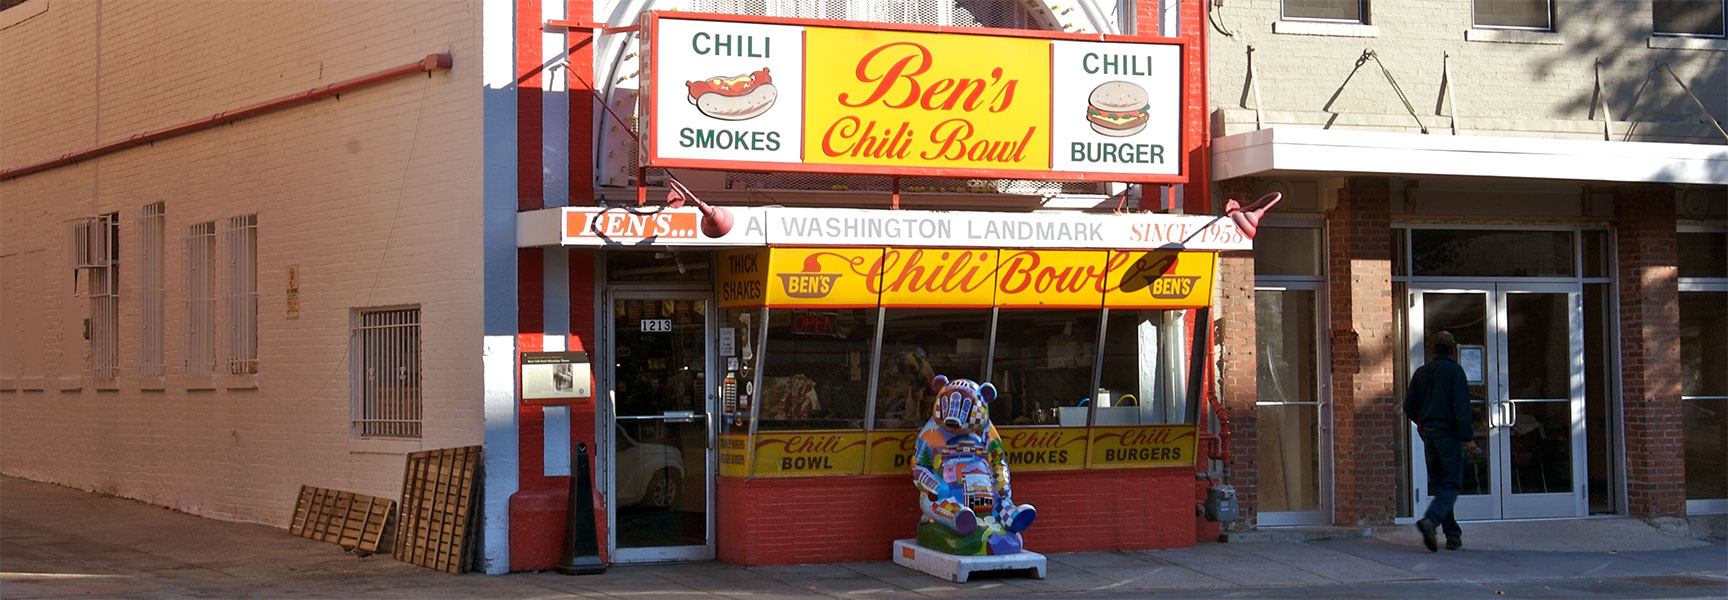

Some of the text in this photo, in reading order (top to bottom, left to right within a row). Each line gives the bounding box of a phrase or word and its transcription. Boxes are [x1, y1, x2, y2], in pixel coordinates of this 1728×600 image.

[692, 31, 770, 58] CHILI
[1082, 52, 1152, 76] CHILI
[838, 41, 1019, 113] Ben's
[679, 127, 781, 151] SMOKES
[821, 115, 1037, 163] Chili Bowl
[1071, 142, 1164, 164] BURGER
[744, 216, 764, 237] A
[781, 216, 951, 239] WASHINGTON
[967, 219, 1104, 241] LANDMARK
[1129, 223, 1244, 244] SINCE 1958
[728, 253, 758, 274] THICK
[865, 249, 1132, 295] Chili Bowl
[722, 280, 761, 301] SHAKES
[788, 275, 830, 294] BEN'S
[1152, 278, 1192, 295] BEN'S
[642, 320, 671, 331] 1213
[793, 314, 833, 333] OPEN
[785, 436, 842, 454] Chili
[1010, 430, 1065, 449] Chili
[1119, 428, 1172, 447] Chili
[782, 456, 833, 470] BOWL
[1004, 450, 1068, 465] MOKES
[1105, 447, 1181, 462] BURGERS
